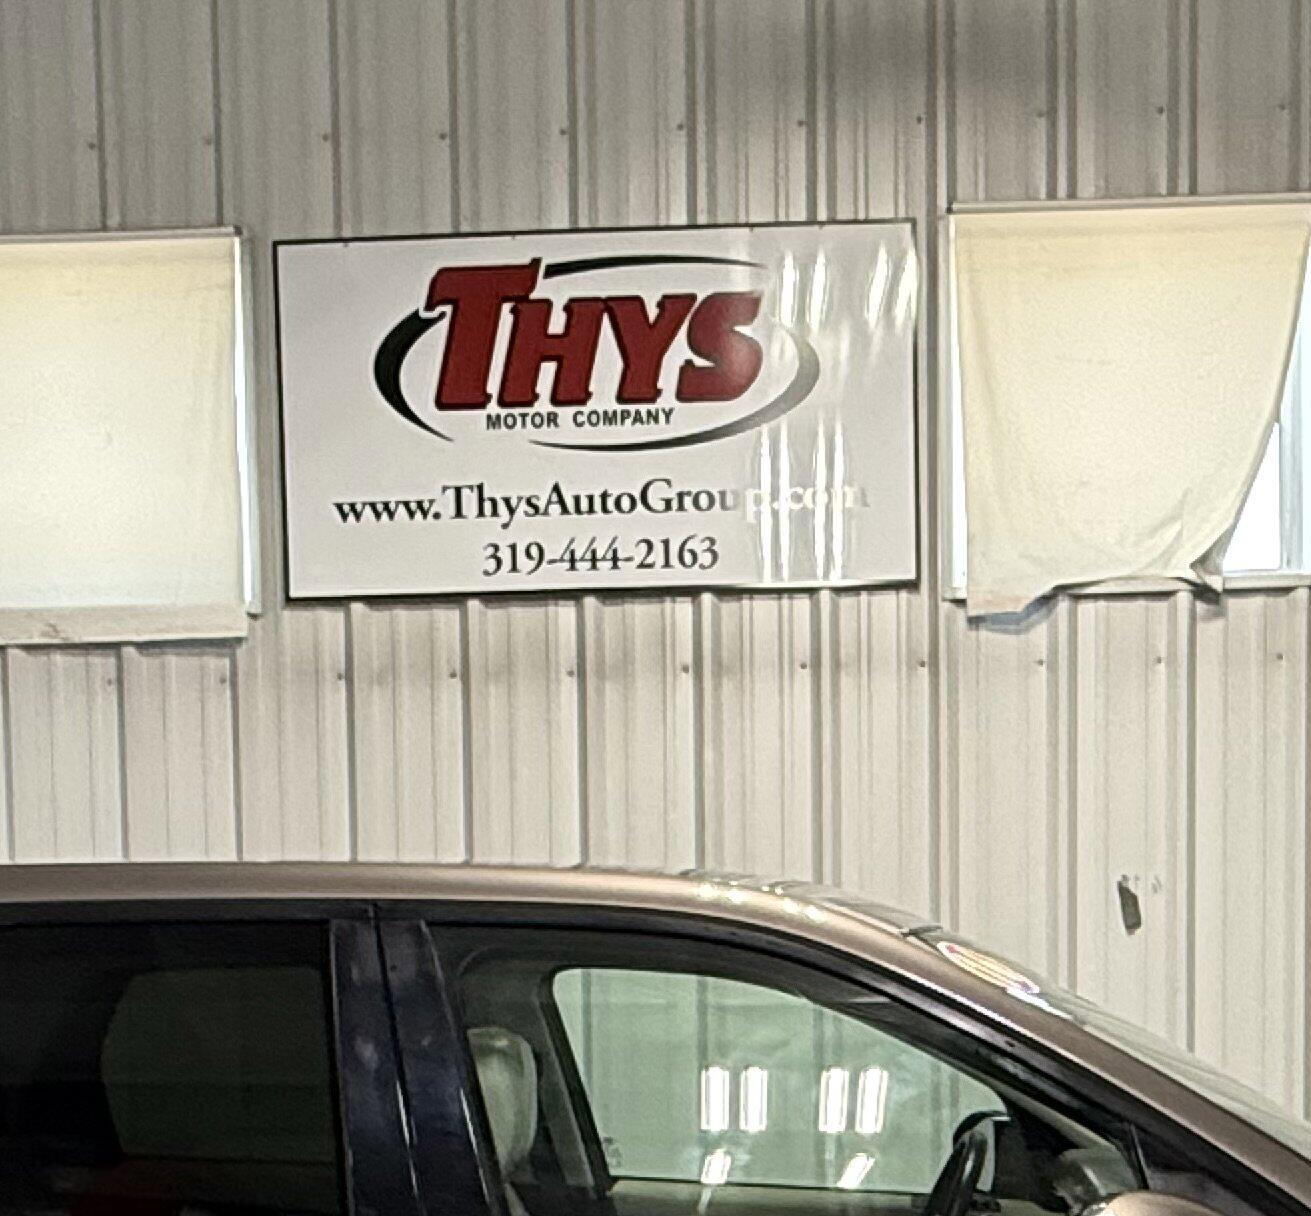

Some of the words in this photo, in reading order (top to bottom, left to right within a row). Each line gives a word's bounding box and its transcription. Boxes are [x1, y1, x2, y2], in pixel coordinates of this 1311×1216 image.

[423, 257, 763, 410] THYS
[485, 412, 559, 430] MOTOR
[573, 407, 674, 428] COMPANY
[482, 533, 719, 577] 319-444-2163
